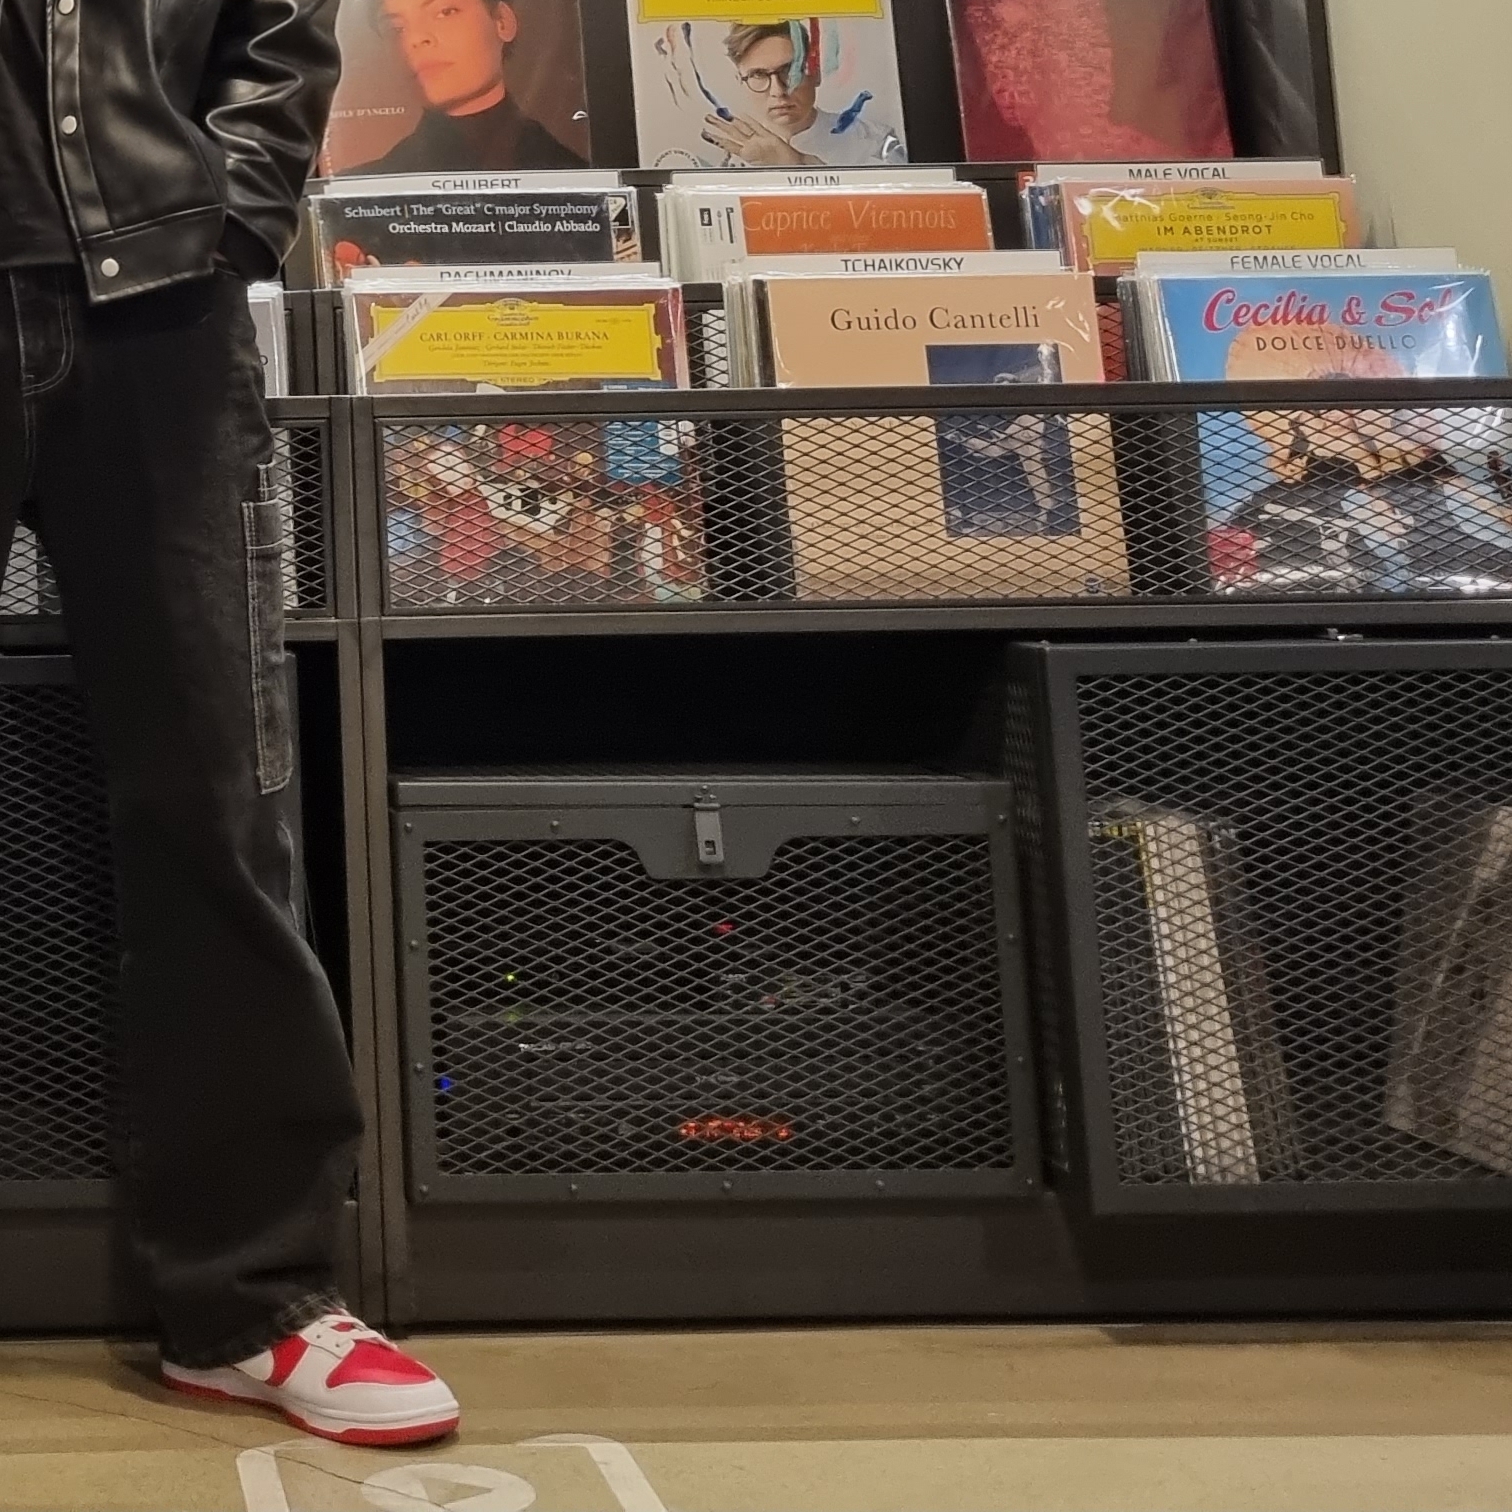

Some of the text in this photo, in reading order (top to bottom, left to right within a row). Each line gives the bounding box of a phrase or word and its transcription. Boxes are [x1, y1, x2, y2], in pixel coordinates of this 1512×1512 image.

[356, 106, 405, 117] D'ANGELO
[1128, 167, 1230, 181] MALE VOCAL
[431, 178, 522, 190] SCHUBERT
[787, 176, 840, 187] VIOLIN
[344, 204, 402, 218] Schubert
[410, 204, 434, 215] The
[483, 204, 493, 215] C
[494, 204, 531, 216] major
[533, 203, 599, 218] Symphony
[1114, 213, 1164, 223] atthias
[1224, 212, 1287, 222] Seong-Jin
[1291, 211, 1315, 221] Cho
[742, 201, 832, 238] Caprice
[847, 201, 957, 230] Viennois
[388, 220, 601, 234] Orchestra Mozart Claudio Abbado
[1156, 225, 1273, 236] IM ABENDROT
[841, 257, 965, 272] TCHAIKOVSKY
[1230, 254, 1367, 269] FEMALE VOCAL
[1202, 286, 1331, 332] Cecilia
[1341, 295, 1367, 327] &
[830, 306, 1041, 332] Guido Cantelli
[419, 331, 610, 342] CARL ORFF CARMINA BURANA
[1256, 334, 1417, 351] DOLCE DUELLO
